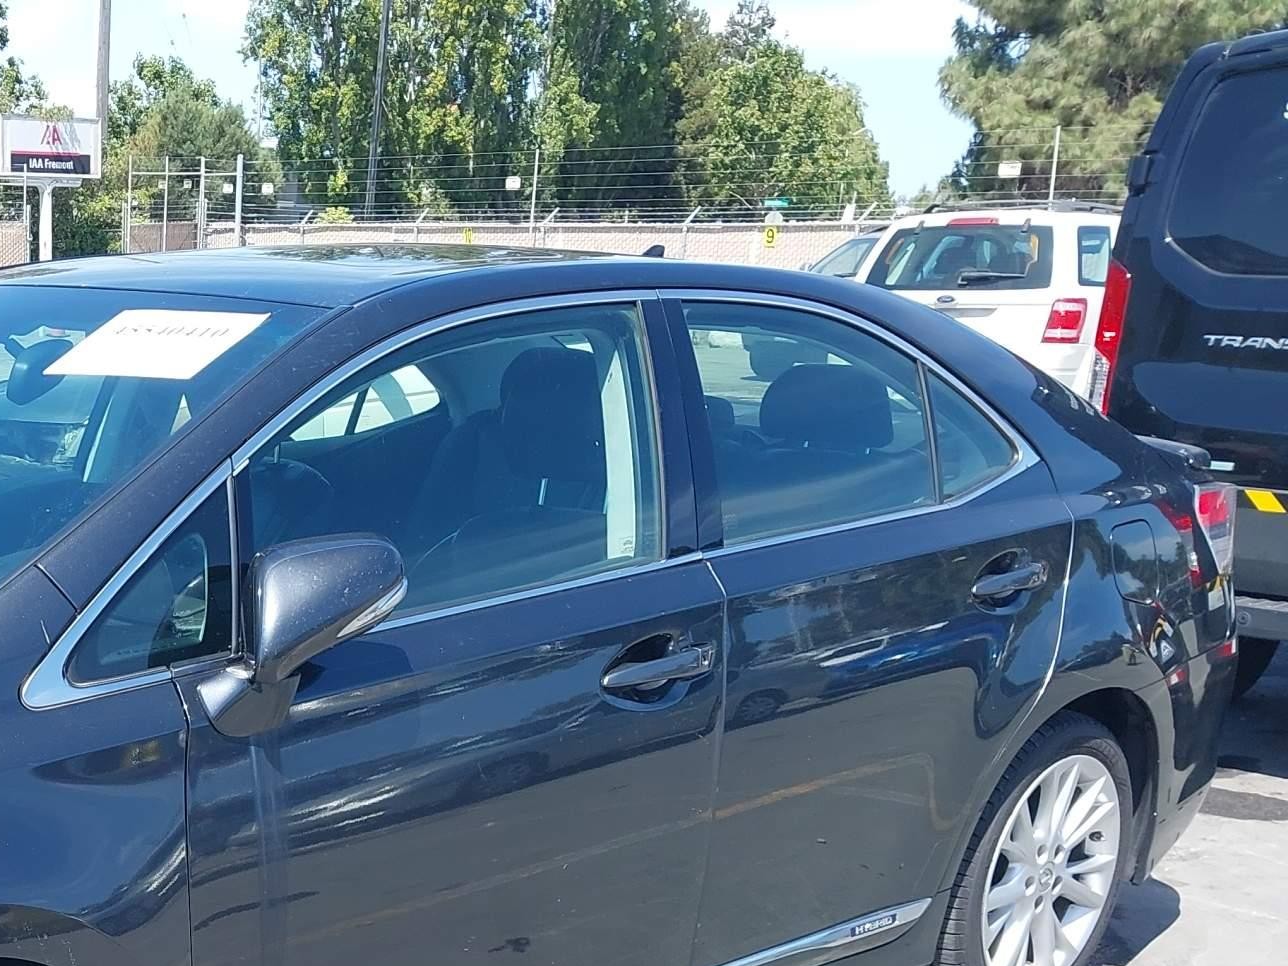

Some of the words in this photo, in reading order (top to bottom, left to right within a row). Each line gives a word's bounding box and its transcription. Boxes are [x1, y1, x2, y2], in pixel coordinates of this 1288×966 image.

[29, 158, 43, 169] IAA
[44, 158, 74, 170] Fremont
[766, 228, 775, 244] 9
